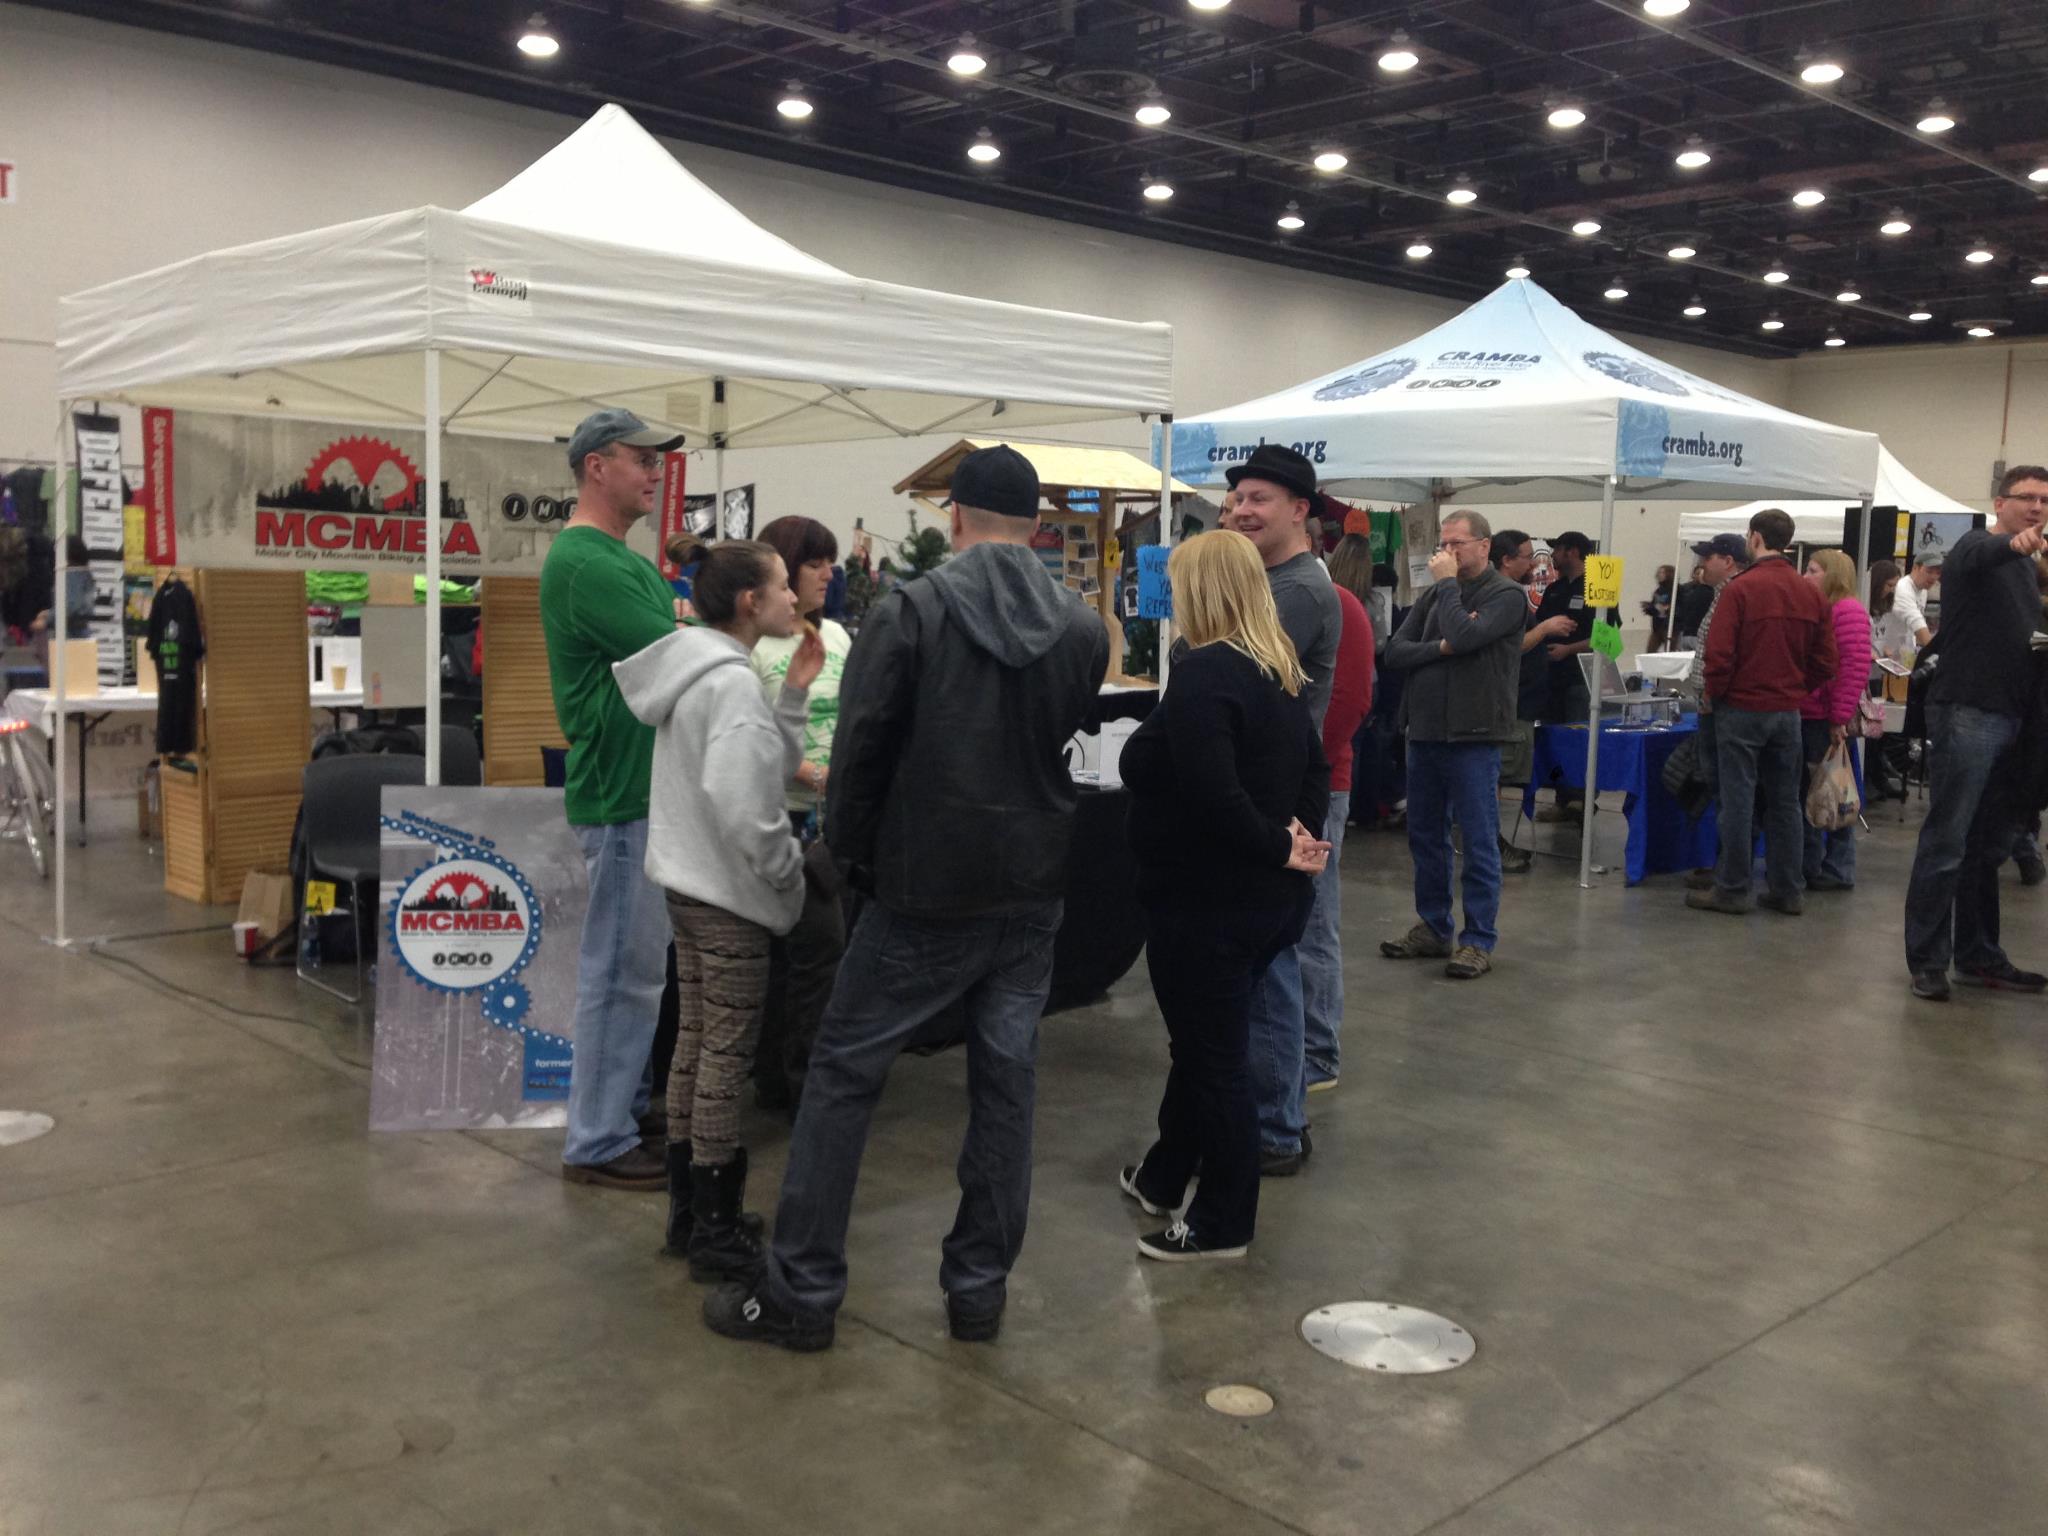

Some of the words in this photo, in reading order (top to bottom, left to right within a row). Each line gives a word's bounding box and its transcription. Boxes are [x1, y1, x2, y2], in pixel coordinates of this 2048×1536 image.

[1437, 351, 1543, 364] CRAMBA
[1207, 436, 1329, 464] cramorg
[1662, 431, 1743, 467] cramba.org
[77, 431, 123, 552] DEFEND
[255, 511, 482, 556] MCMBA
[255, 549, 291, 559] Motor
[295, 550, 318, 561] City
[321, 551, 376, 562] Mountain
[417, 554, 481, 565] Aociation
[401, 809, 474, 841] Welcome
[479, 836, 496, 849] to
[400, 911, 525, 931] MCMBA
